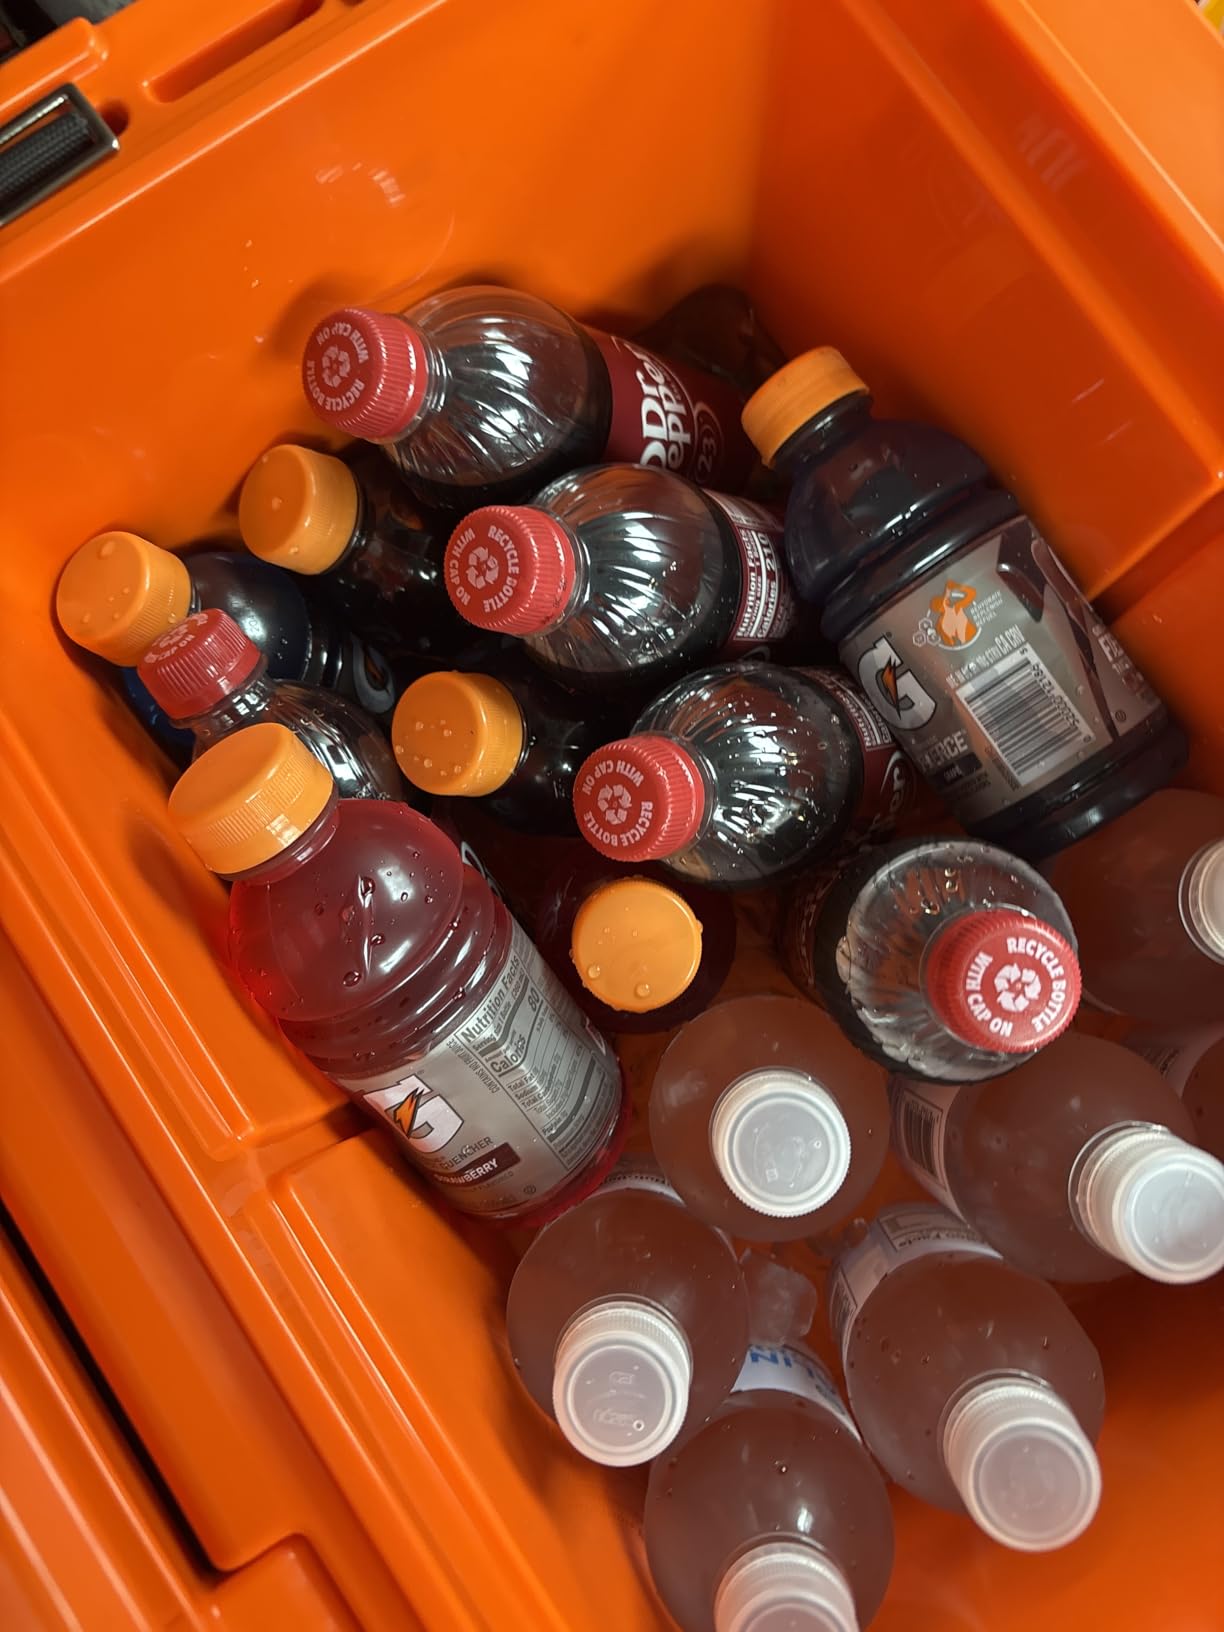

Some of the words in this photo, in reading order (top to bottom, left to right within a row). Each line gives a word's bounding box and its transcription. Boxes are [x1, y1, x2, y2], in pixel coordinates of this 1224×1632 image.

[316, 327, 331, 345] ON
[331, 322, 352, 336] CAP
[349, 330, 369, 364] WITH
[306, 360, 325, 406] BOTTLE
[325, 379, 365, 411] RECYCLE
[636, 370, 667, 441] Dr
[452, 528, 476, 558] WITH
[487, 525, 520, 574] RECYCLE
[740, 528, 757, 568] Facts
[757, 532, 776, 572] 210
[449, 560, 460, 585] CAP
[455, 586, 471, 605] ON
[483, 576, 517, 613] BOTTLE
[737, 572, 757, 638] Nutrition
[757, 581, 777, 638] Calories
[995, 631, 1010, 650] CA
[1008, 623, 1026, 647] CRV
[858, 634, 937, 731] G
[594, 760, 614, 778] CAP
[919, 730, 968, 773] FIERCE
[582, 775, 595, 796] ON
[616, 760, 645, 787] WITH
[583, 811, 618, 847] BOTTLE
[620, 801, 654, 847] RECYCLE
[965, 951, 993, 991] WITH
[1006, 936, 1064, 979] RECYCLE
[461, 990, 505, 1042] Nutrition
[502, 956, 520, 988] Facts
[967, 993, 992, 1021] CAP
[1032, 979, 1067, 1033] BOTTLE
[472, 1033, 497, 1052] Serving
[490, 1034, 527, 1073] Calories
[528, 987, 540, 1012] 80
[989, 1017, 1013, 1037] ON
[474, 1067, 500, 1094] CONTAINS
[508, 1079, 525, 1092] Total
[523, 1073, 535, 1083] Fat
[441, 1136, 494, 1170] QUENCHER
